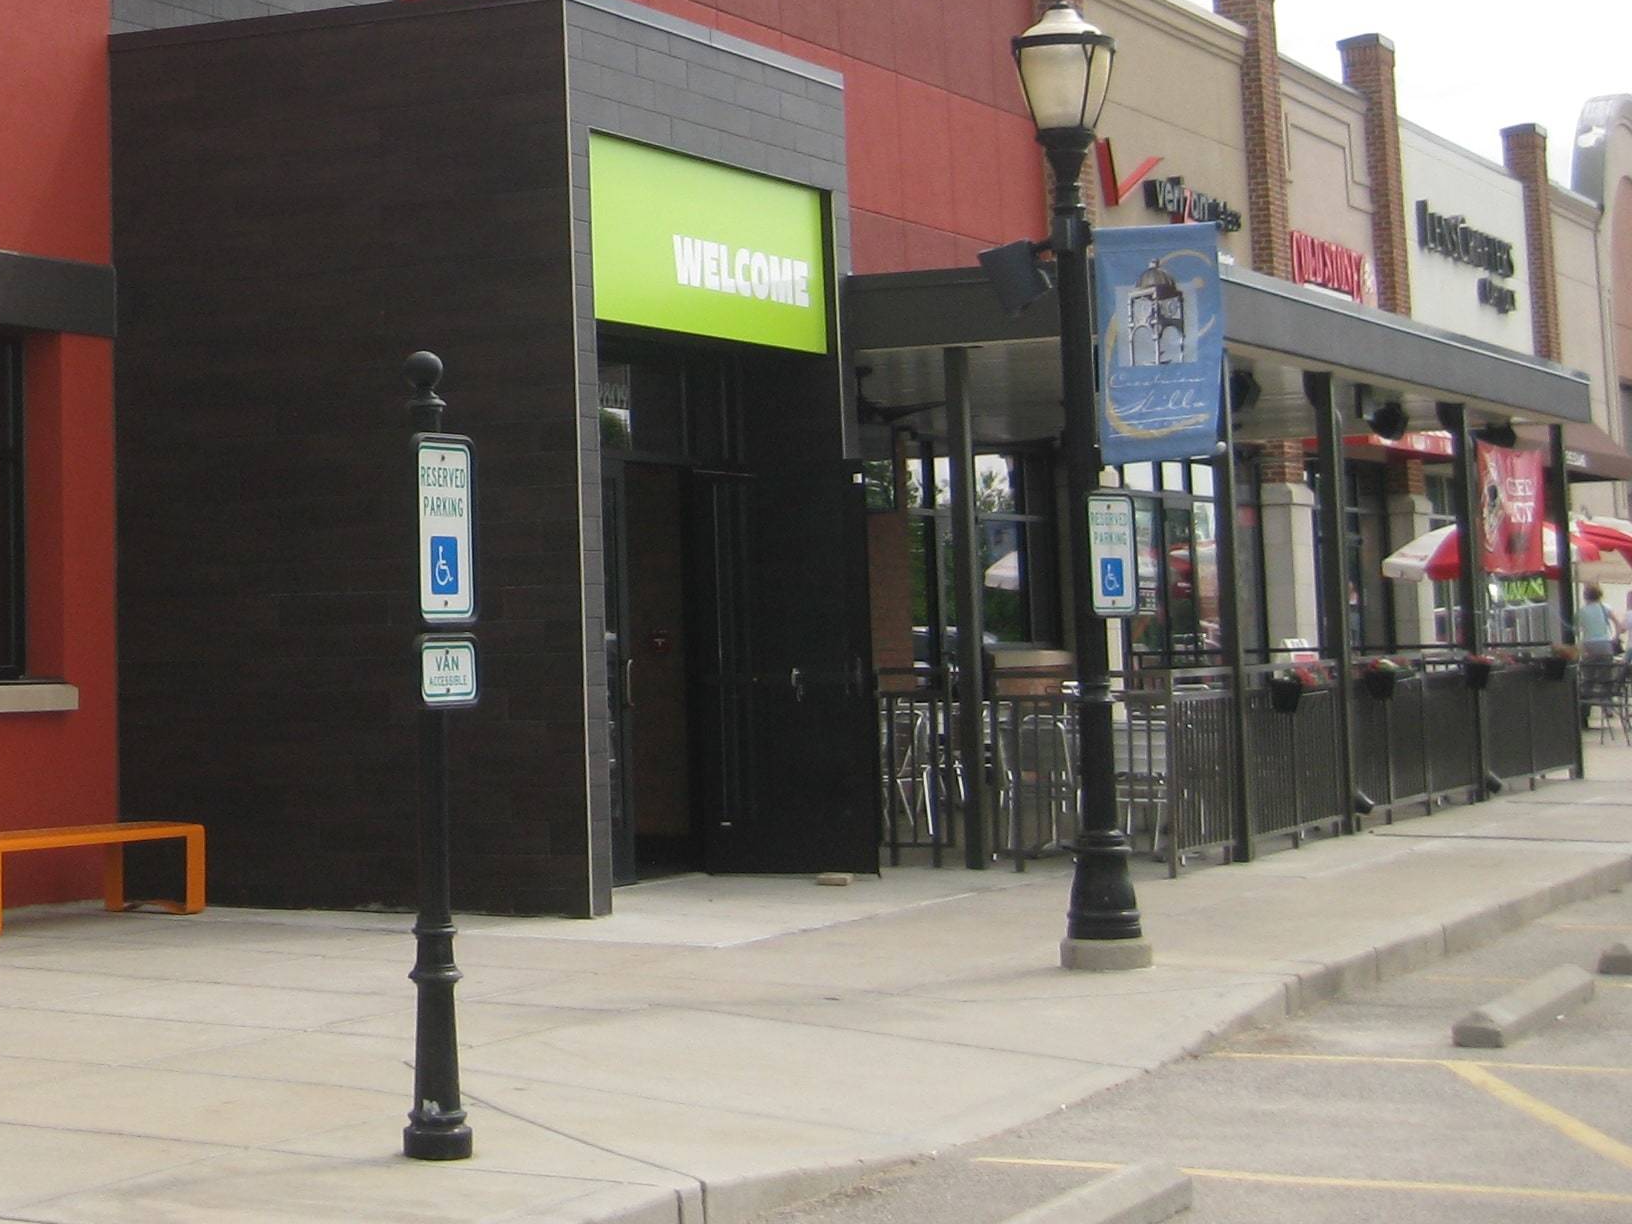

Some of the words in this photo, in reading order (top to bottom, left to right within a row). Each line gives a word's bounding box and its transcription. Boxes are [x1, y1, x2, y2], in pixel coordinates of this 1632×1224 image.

[673, 234, 810, 308] WELCOME
[420, 466, 466, 490] RESERVED
[423, 495, 464, 518] PARKING
[1089, 512, 1129, 527] RESERVED
[1094, 531, 1127, 546] PARKING
[435, 655, 460, 672] VAN
[428, 674, 468, 687] ACCESSIBLE
